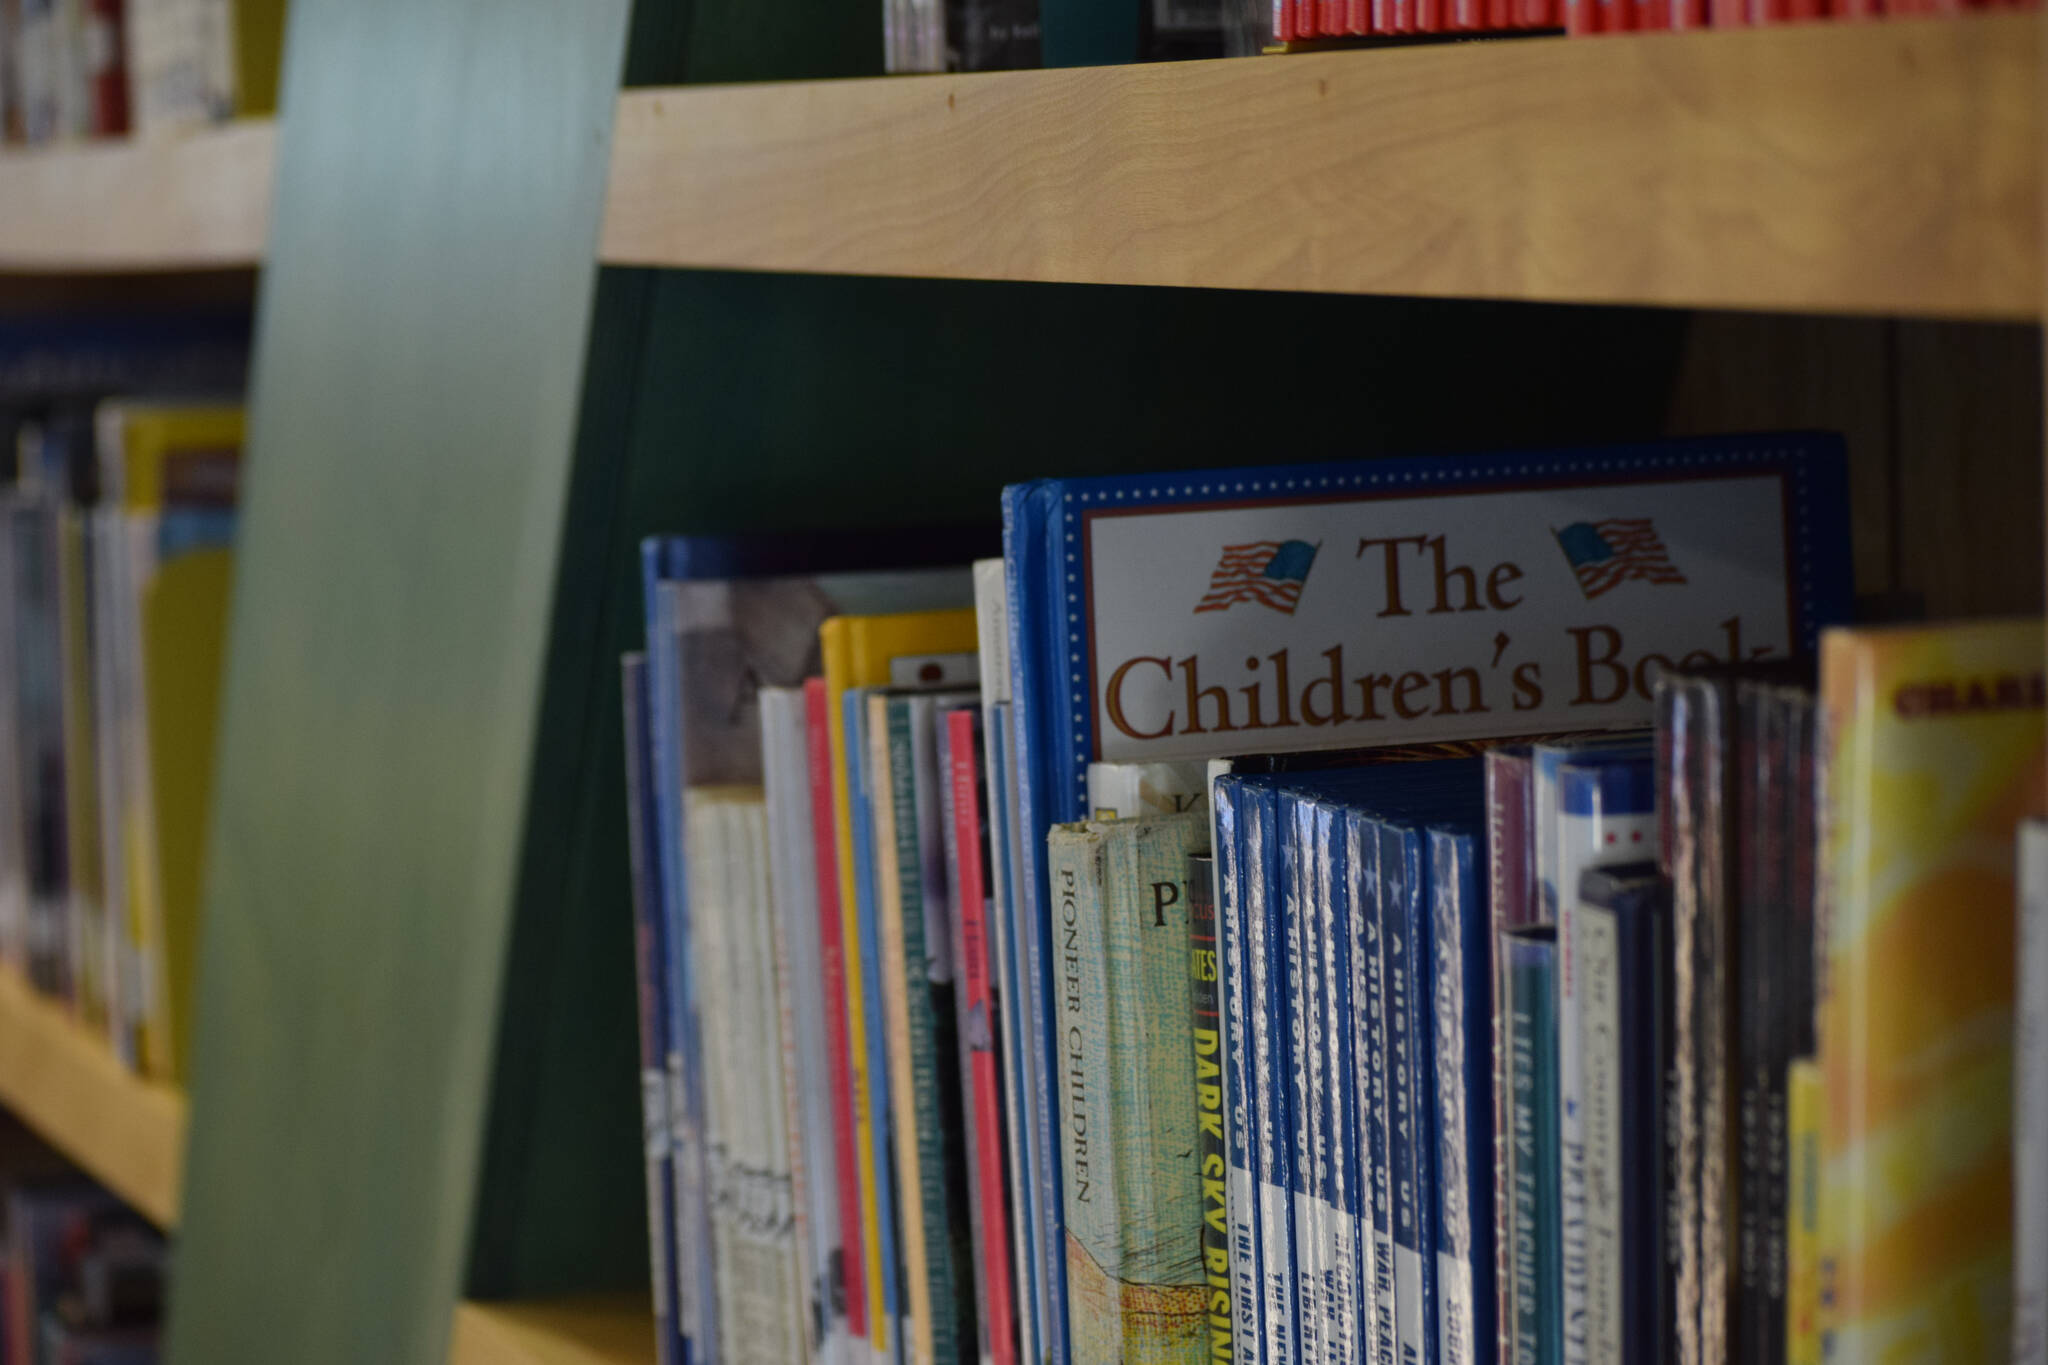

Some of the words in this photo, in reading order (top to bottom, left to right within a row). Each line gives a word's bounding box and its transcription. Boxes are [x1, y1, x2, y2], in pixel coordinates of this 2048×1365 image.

[1356, 532, 1525, 619] The
[1105, 630, 1544, 740] Children's
[1222, 873, 1234, 895] A
[1285, 894, 1296, 916] A
[1305, 895, 1316, 918] A
[1060, 868, 1081, 1014] PIONEER
[1367, 919, 1378, 944] A
[1391, 932, 1403, 956] A
[1439, 938, 1450, 961] A
[1226, 907, 1241, 1066] HISTORY
[1254, 920, 1270, 1081] HISTORY
[1288, 928, 1303, 1092] HISTORY
[1307, 930, 1324, 1096] HISTORY
[1369, 955, 1383, 1127] HISTORY
[1394, 967, 1408, 1141] HISTORY
[1440, 973, 1456, 1146] HISTORY
[1513, 1011, 1533, 1093] LIES
[1068, 1025, 1091, 1204] CHILDREN
[1193, 1026, 1223, 1142] DARK
[1234, 1105, 1245, 1150] US
[1297, 1130, 1309, 1176] US
[1317, 1134, 1328, 1181] US
[1513, 1103, 1533, 1158] MY
[1201, 1153, 1227, 1234] SKY
[1376, 1165, 1387, 1213] US
[1401, 1179, 1411, 1228] US
[1237, 1223, 1253, 1266] THE
[1515, 1172, 1536, 1315] TEACHER
[1205, 1246, 1234, 1365] RISIN
[1238, 1272, 1256, 1341] FIRST
[1268, 1272, 1285, 1316] THE
[1243, 1346, 1257, 1365] A
